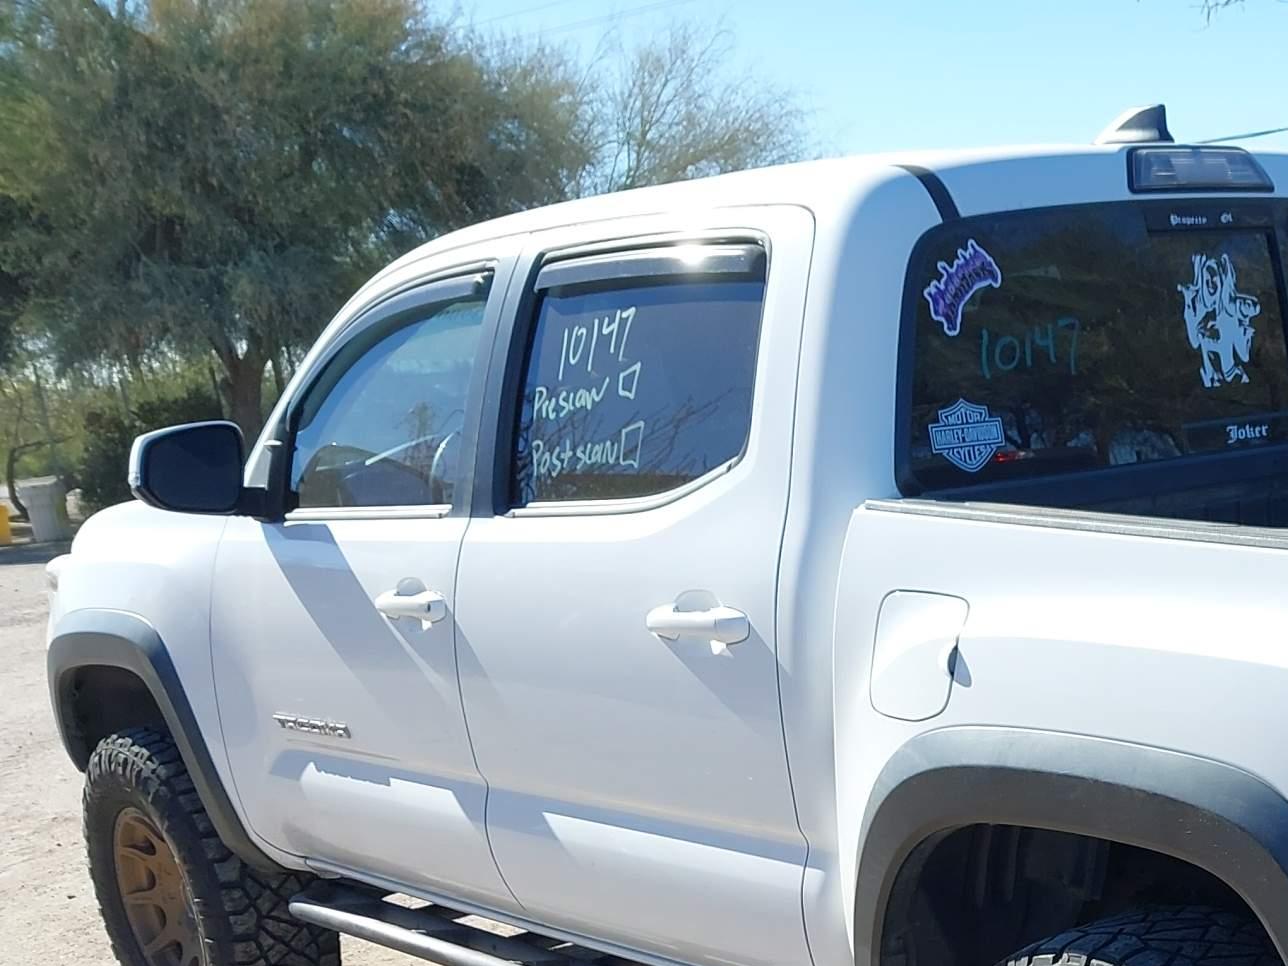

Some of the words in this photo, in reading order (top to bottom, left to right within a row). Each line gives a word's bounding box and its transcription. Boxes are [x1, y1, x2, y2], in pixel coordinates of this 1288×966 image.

[558, 307, 637, 381] 10147
[980, 317, 1080, 380] 10147
[947, 408, 982, 425] MOTOR
[1225, 423, 1269, 444] Joker
